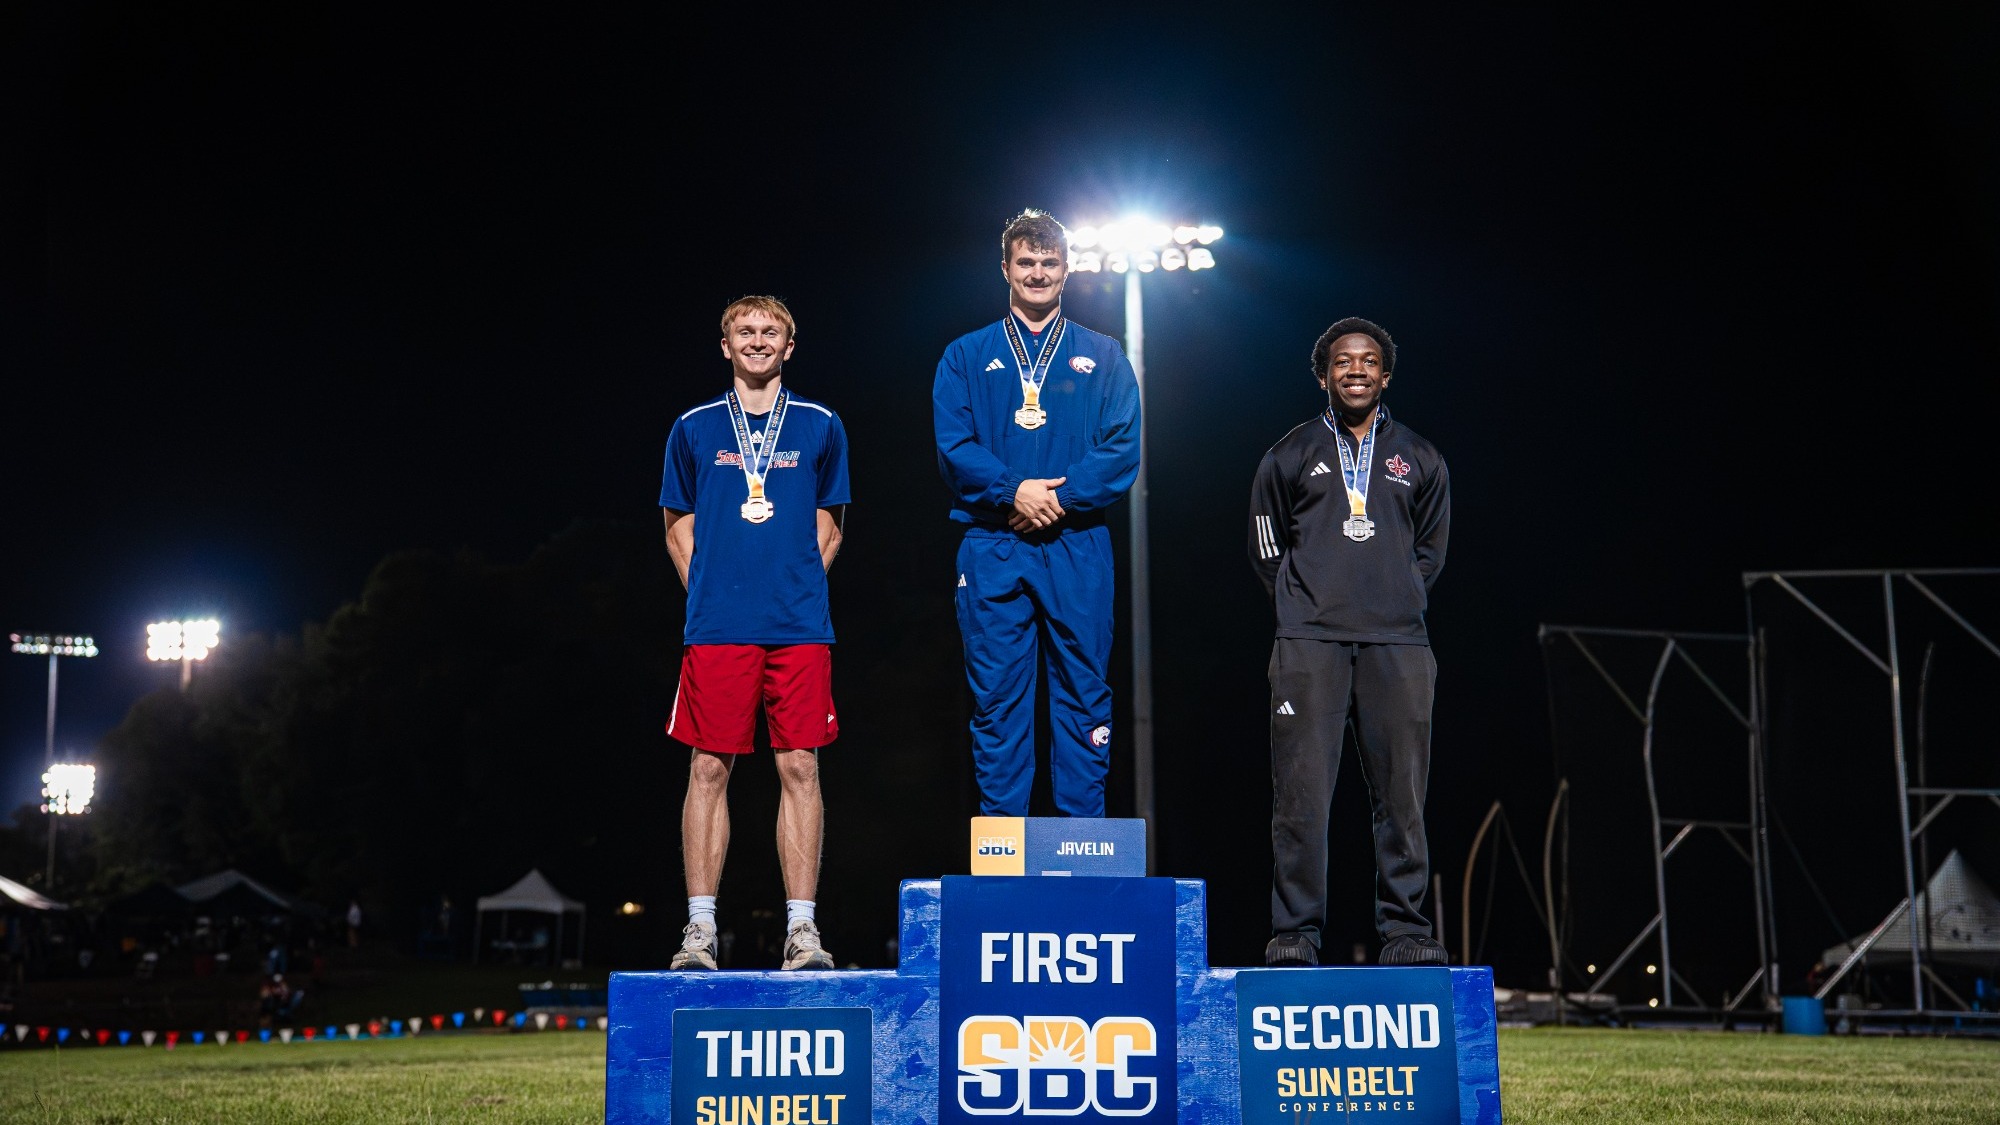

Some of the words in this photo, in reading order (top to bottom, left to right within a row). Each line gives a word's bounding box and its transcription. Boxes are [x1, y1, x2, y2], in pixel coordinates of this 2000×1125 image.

[978, 837, 1016, 856] SBC
[1056, 841, 1114, 856] JAVELIN
[981, 932, 1136, 984] FIRST
[1252, 1003, 1441, 1051] SECOND
[695, 1029, 845, 1078] THIRD
[957, 1015, 1158, 1117] SBC
[1277, 1067, 1342, 1097] SUN
[1346, 1066, 1420, 1096] BELT
[696, 1095, 764, 1125] SUN
[770, 1094, 847, 1125] BELT
[1279, 1101, 1415, 1113] CONFERENCE
